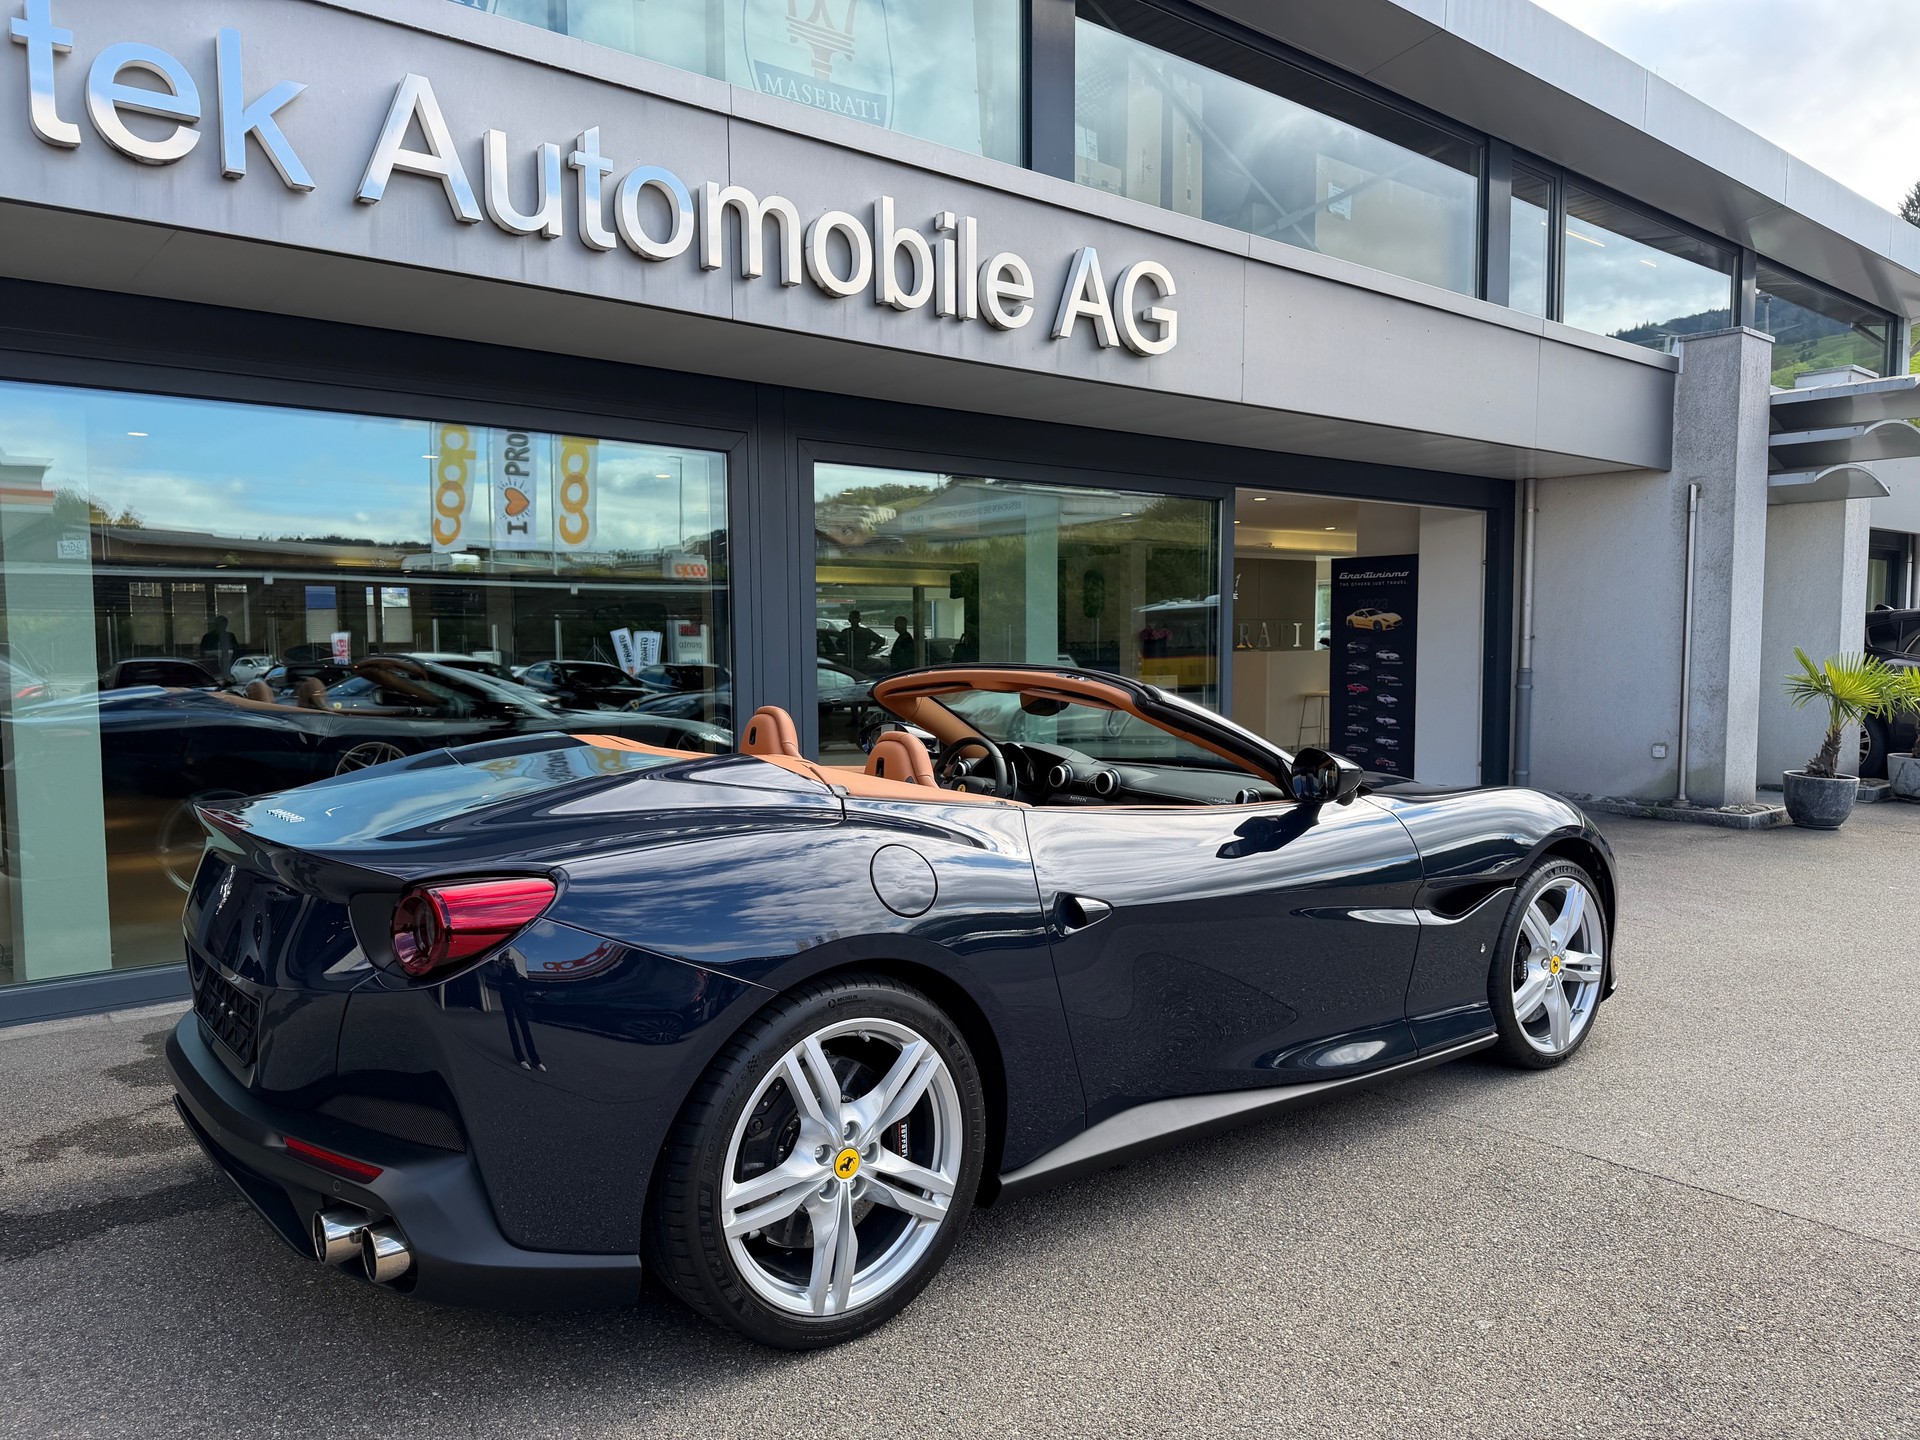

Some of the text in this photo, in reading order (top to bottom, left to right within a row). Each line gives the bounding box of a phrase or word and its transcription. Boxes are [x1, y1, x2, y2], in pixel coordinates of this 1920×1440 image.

[763, 73, 881, 121] MASERATI
[10, 0, 1178, 357] tek Automobile AG
[504, 429, 530, 477] PRO
[1339, 571, 1409, 580] GranTurismo
[715, 1091, 737, 1133] SPORT
